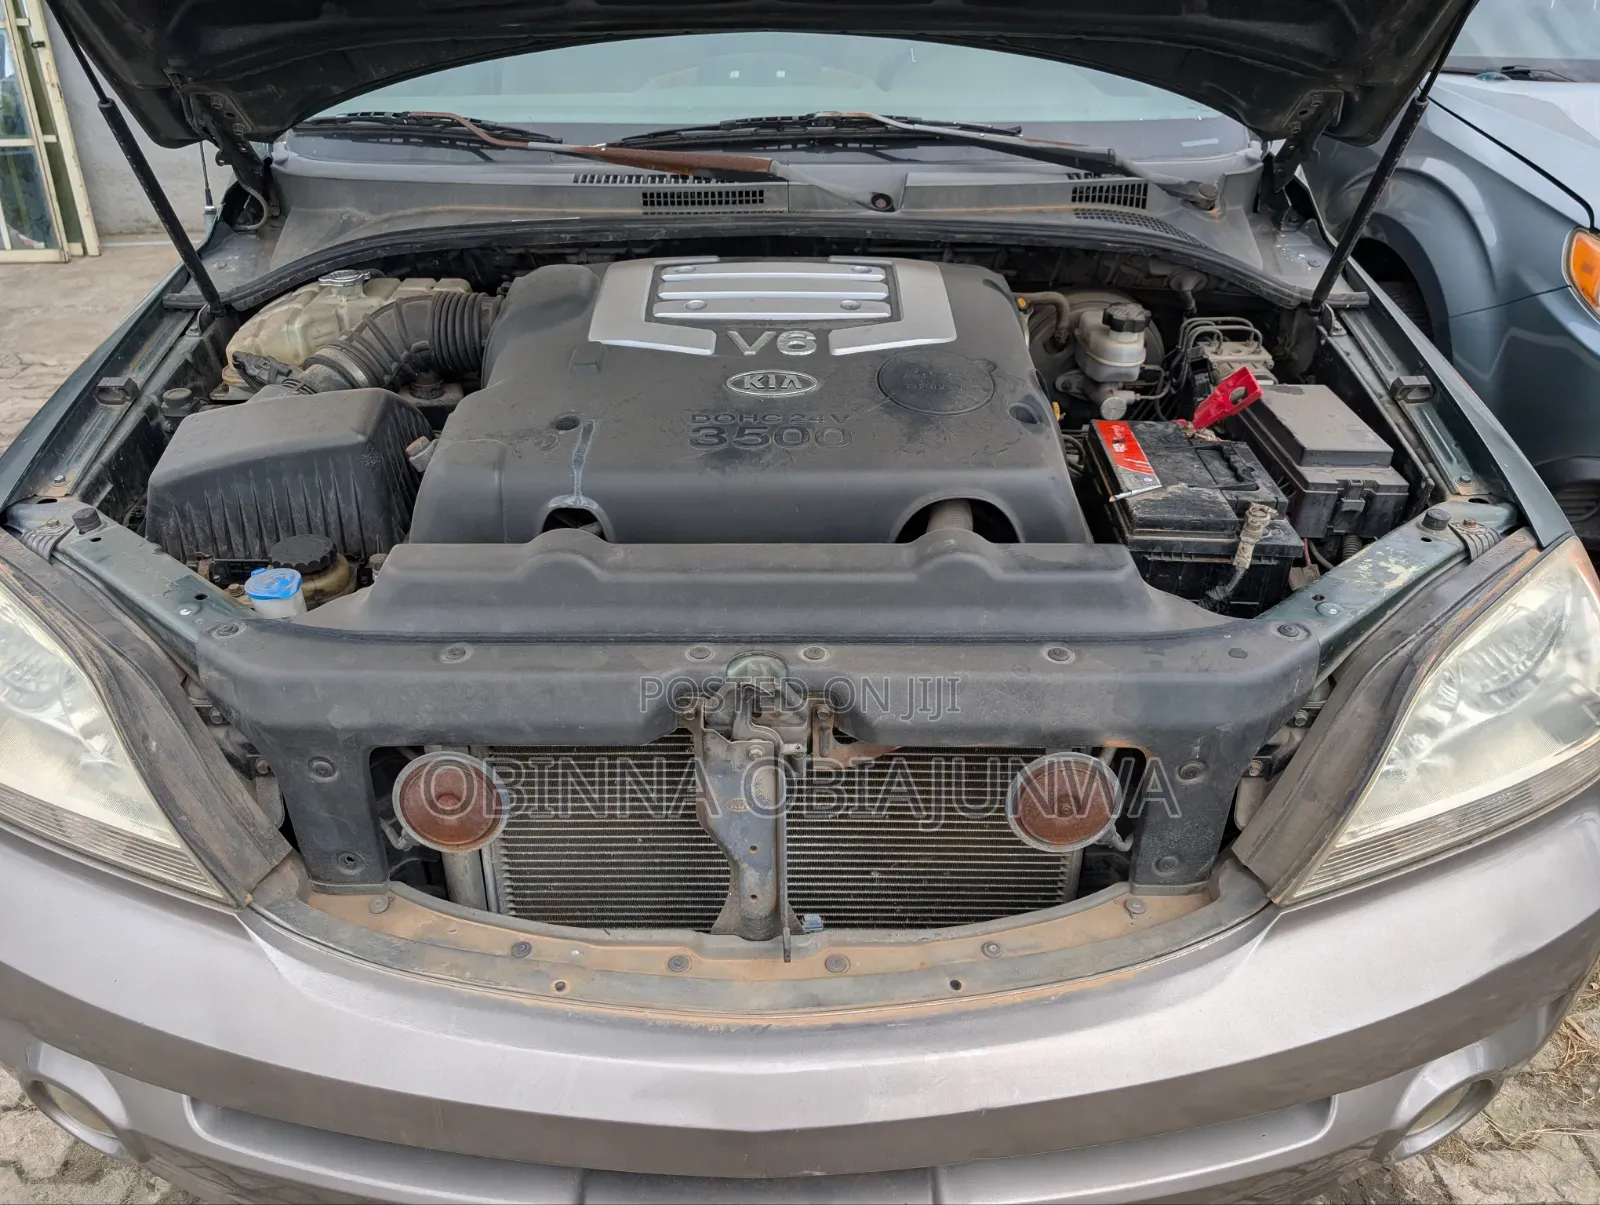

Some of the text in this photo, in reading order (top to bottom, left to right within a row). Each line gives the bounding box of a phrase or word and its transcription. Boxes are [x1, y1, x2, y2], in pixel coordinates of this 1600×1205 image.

[726, 330, 818, 356] V6
[743, 374, 802, 390] KIA
[691, 413, 782, 425] DOHC
[689, 426, 853, 450] 3500
